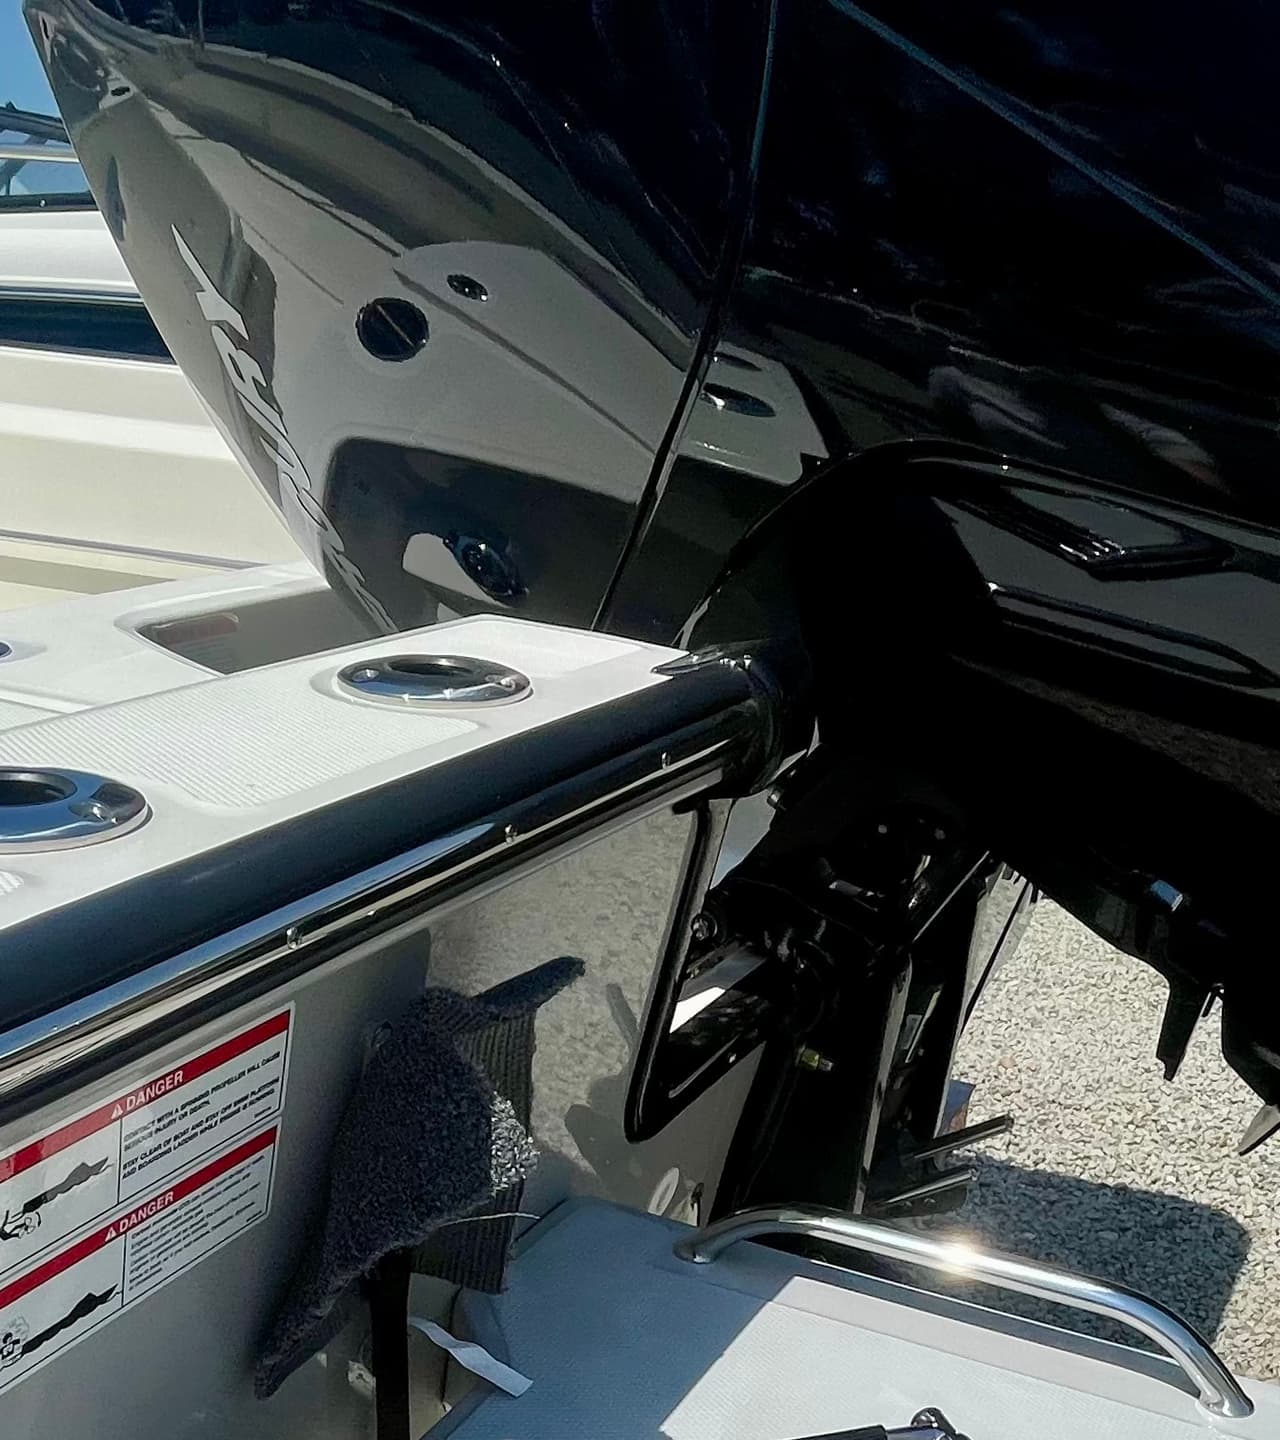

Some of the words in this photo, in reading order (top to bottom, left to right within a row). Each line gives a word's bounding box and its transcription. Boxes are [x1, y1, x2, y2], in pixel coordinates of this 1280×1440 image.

[172, 224, 400, 632] ERCURY
[125, 1071, 184, 1109] DANGER
[120, 1191, 174, 1232] DANGER
